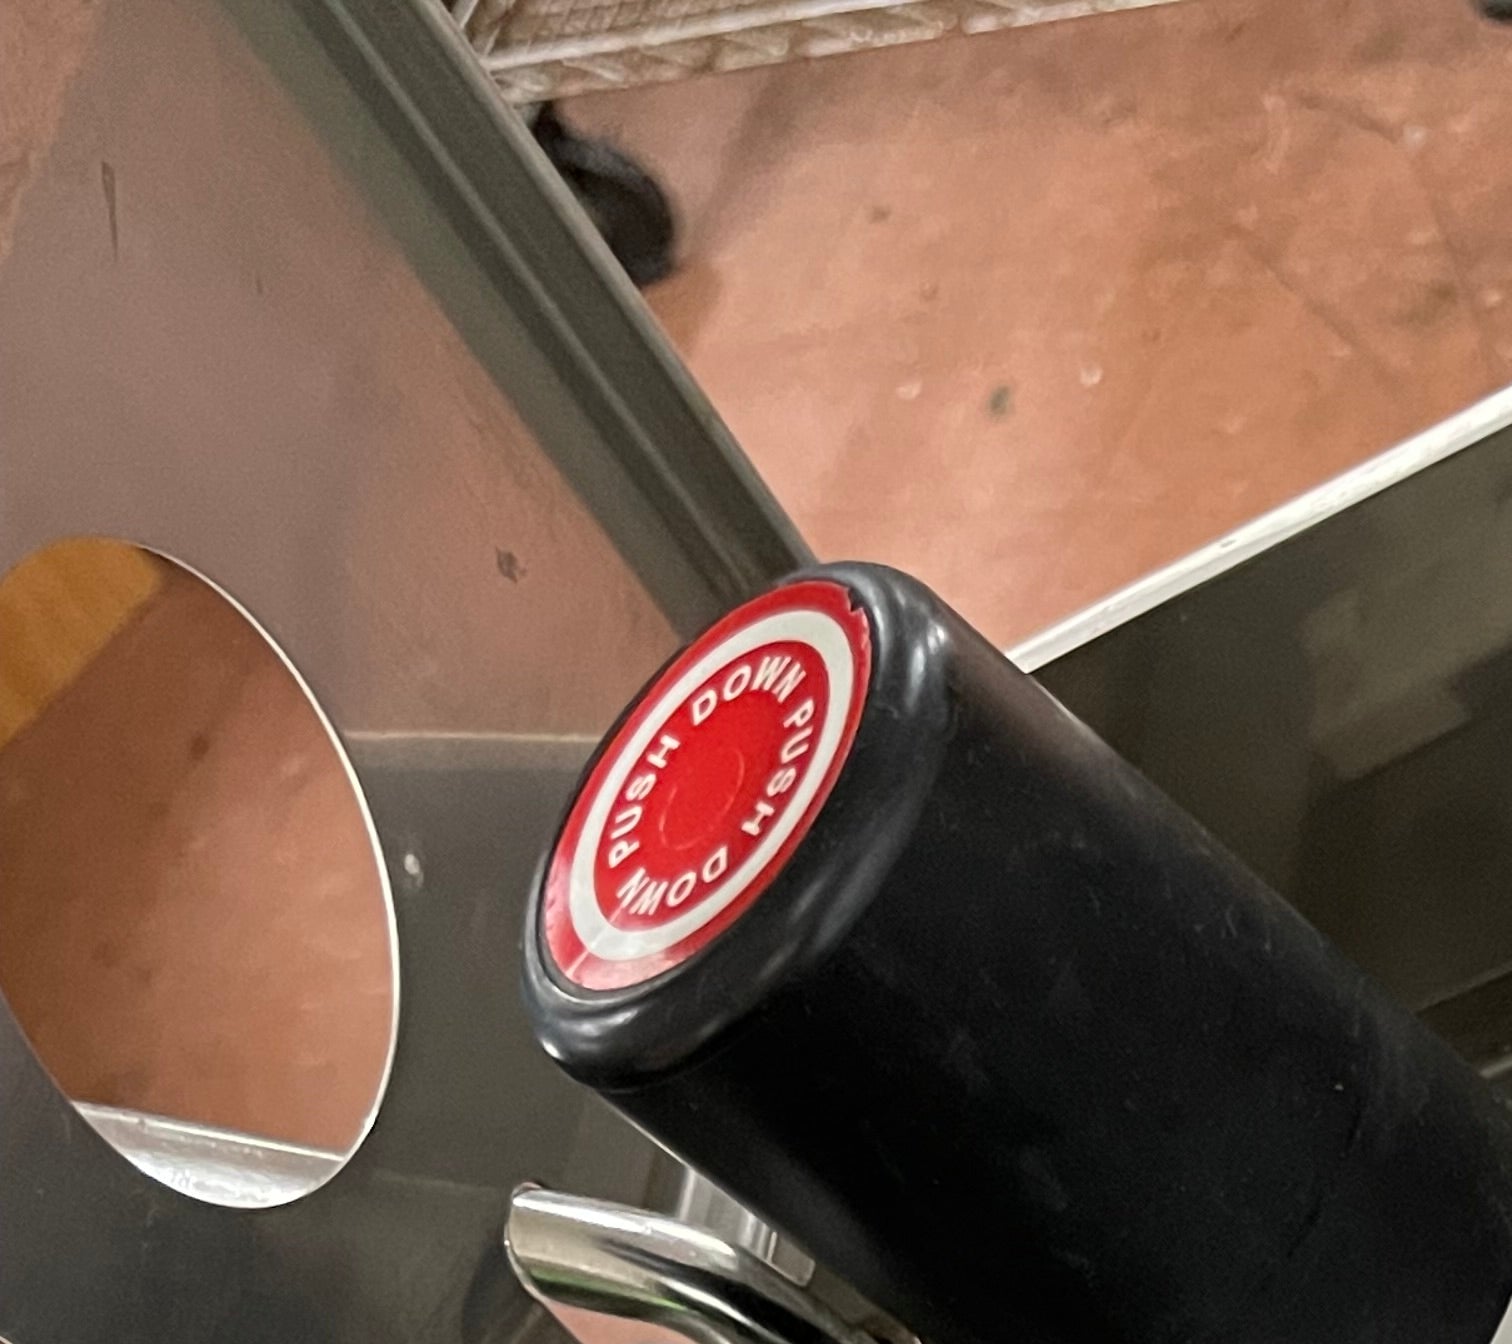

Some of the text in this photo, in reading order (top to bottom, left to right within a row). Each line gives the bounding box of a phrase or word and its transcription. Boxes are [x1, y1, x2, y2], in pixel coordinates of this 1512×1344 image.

[609, 656, 805, 868] PUSH DOWN
[617, 700, 815, 916] PUSH DOWN
